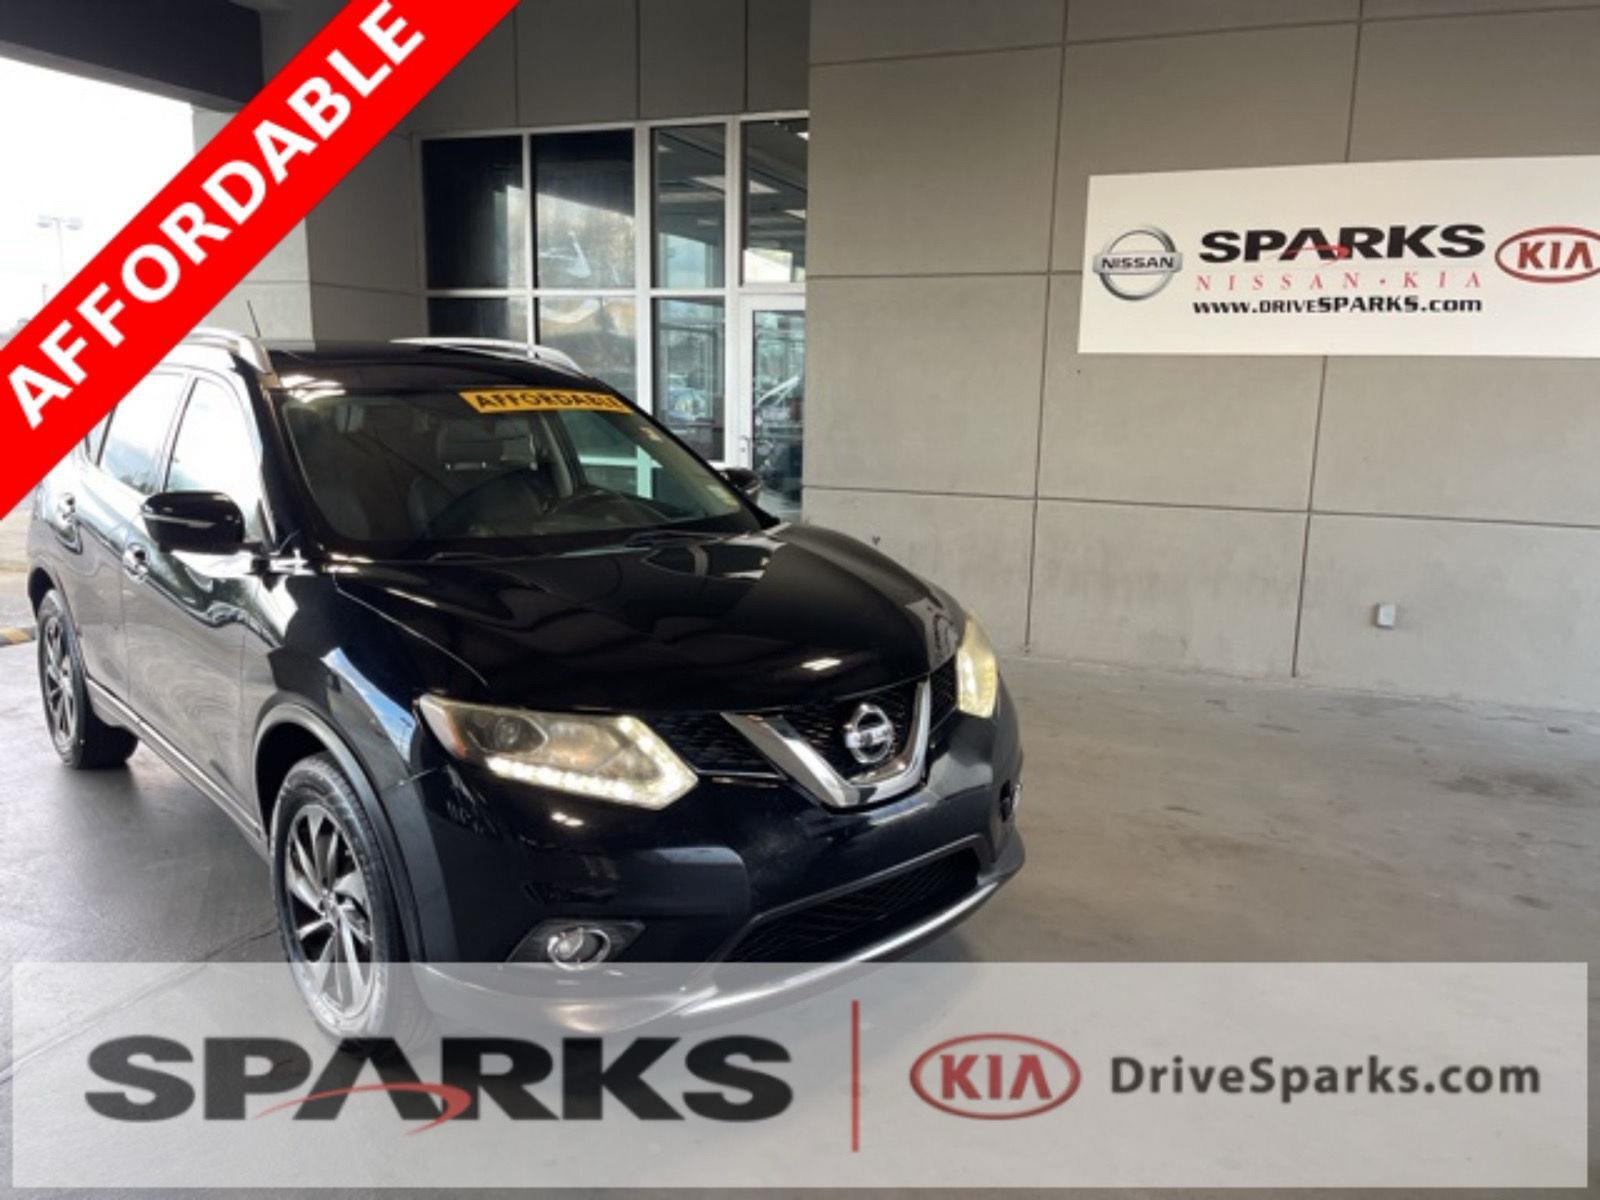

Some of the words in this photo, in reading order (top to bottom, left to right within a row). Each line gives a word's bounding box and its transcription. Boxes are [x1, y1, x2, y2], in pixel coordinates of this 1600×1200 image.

[1199, 223, 1486, 264] SPARKS
[1101, 256, 1174, 270] NISSAN
[1517, 241, 1593, 270] KIA
[474, 391, 622, 409] AFFORDABLE
